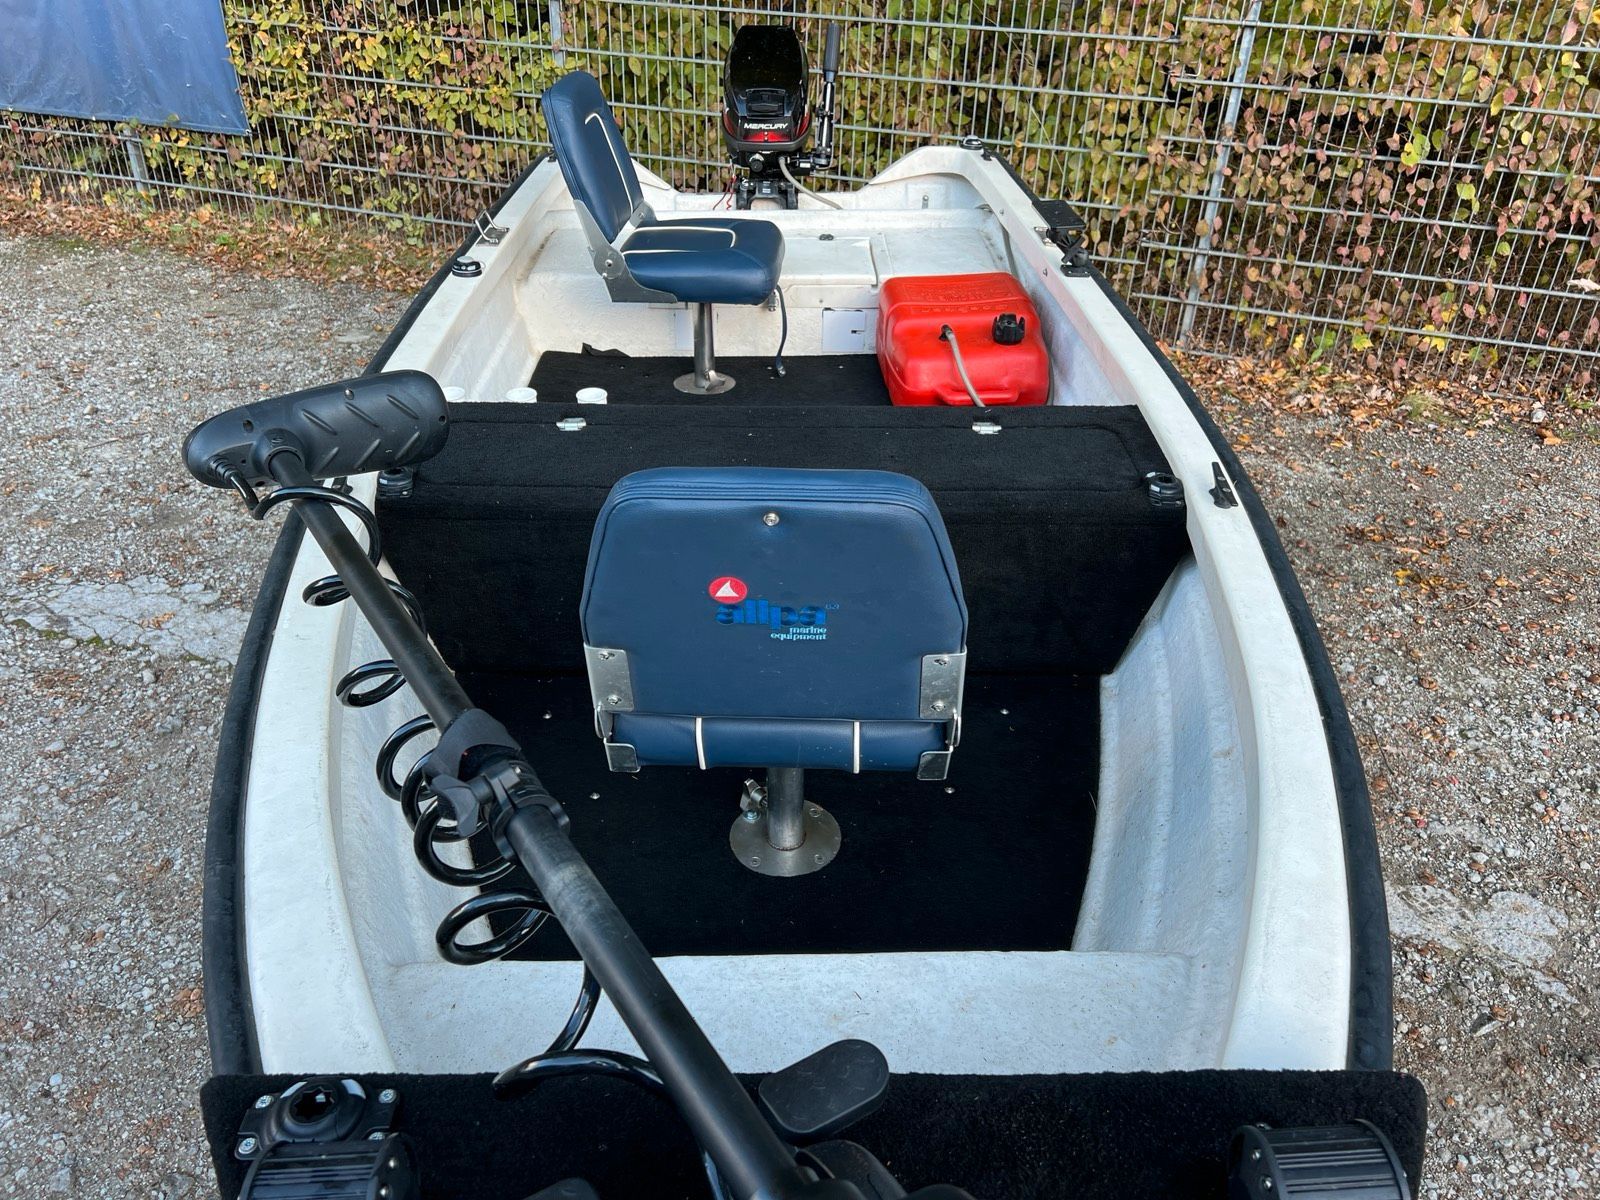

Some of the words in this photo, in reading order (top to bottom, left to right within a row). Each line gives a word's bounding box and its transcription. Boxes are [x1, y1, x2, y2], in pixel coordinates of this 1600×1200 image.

[716, 599, 826, 630] allpa
[789, 626, 827, 634] marine
[770, 632, 827, 640] equipment
